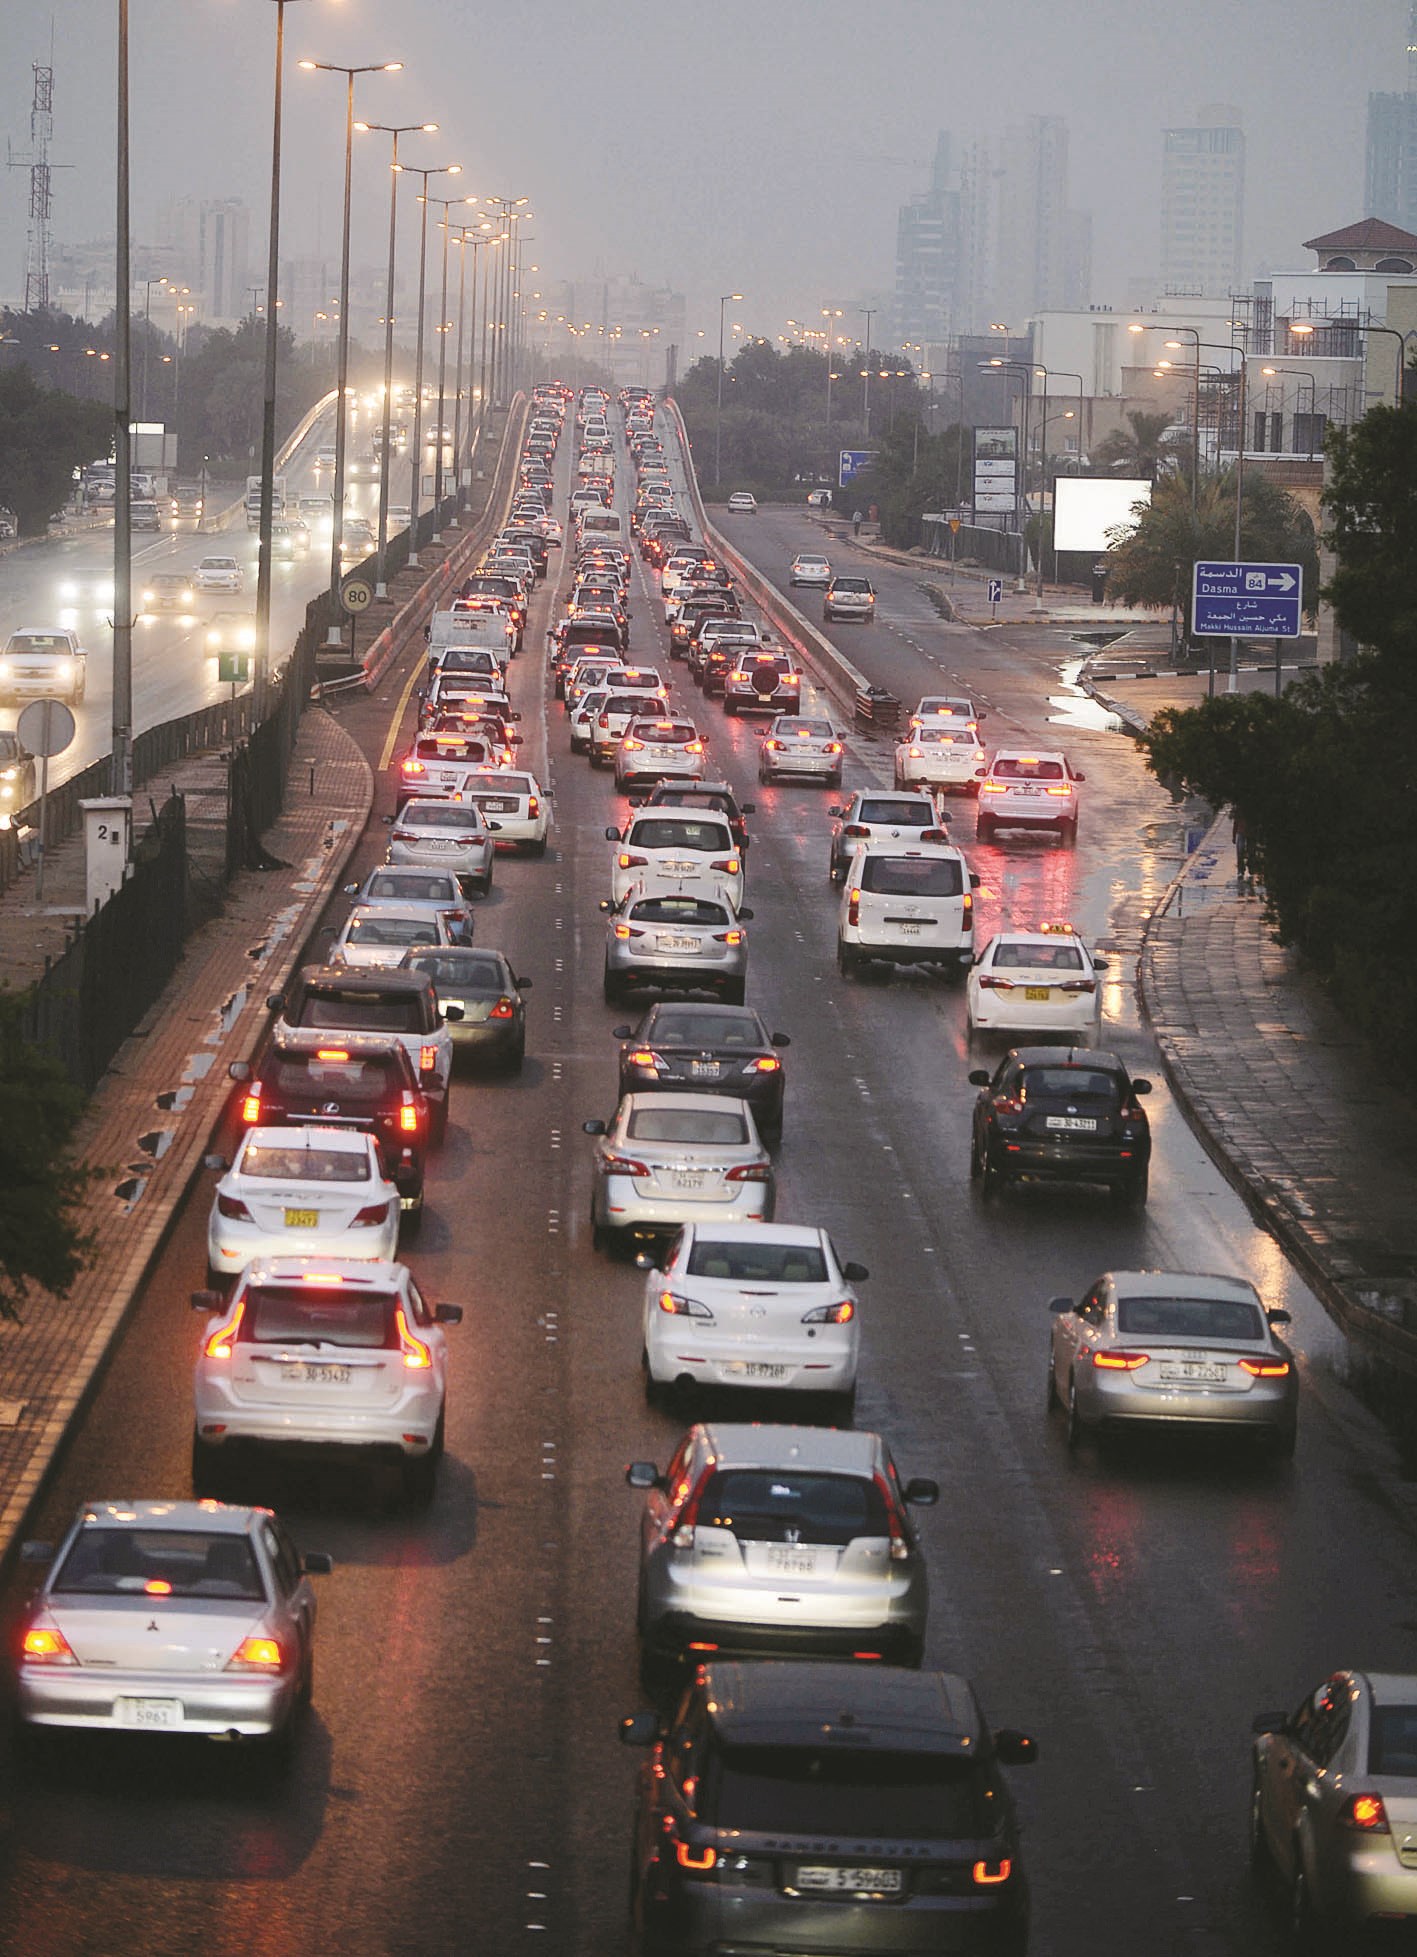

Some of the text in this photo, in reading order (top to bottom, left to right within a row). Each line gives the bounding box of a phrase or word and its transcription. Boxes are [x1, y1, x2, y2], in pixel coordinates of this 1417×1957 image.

[1199, 567, 1242, 578] الدسمة
[1202, 583, 1238, 594] Dasma
[1248, 579, 1263, 588] 84
[349, 590, 367, 603] 80
[1236, 601, 1258, 610] شارع
[1200, 623, 1221, 631] Makki
[1223, 624, 1252, 632] Hussain
[229, 655, 239, 675] 1
[98, 825, 107, 840] 2
